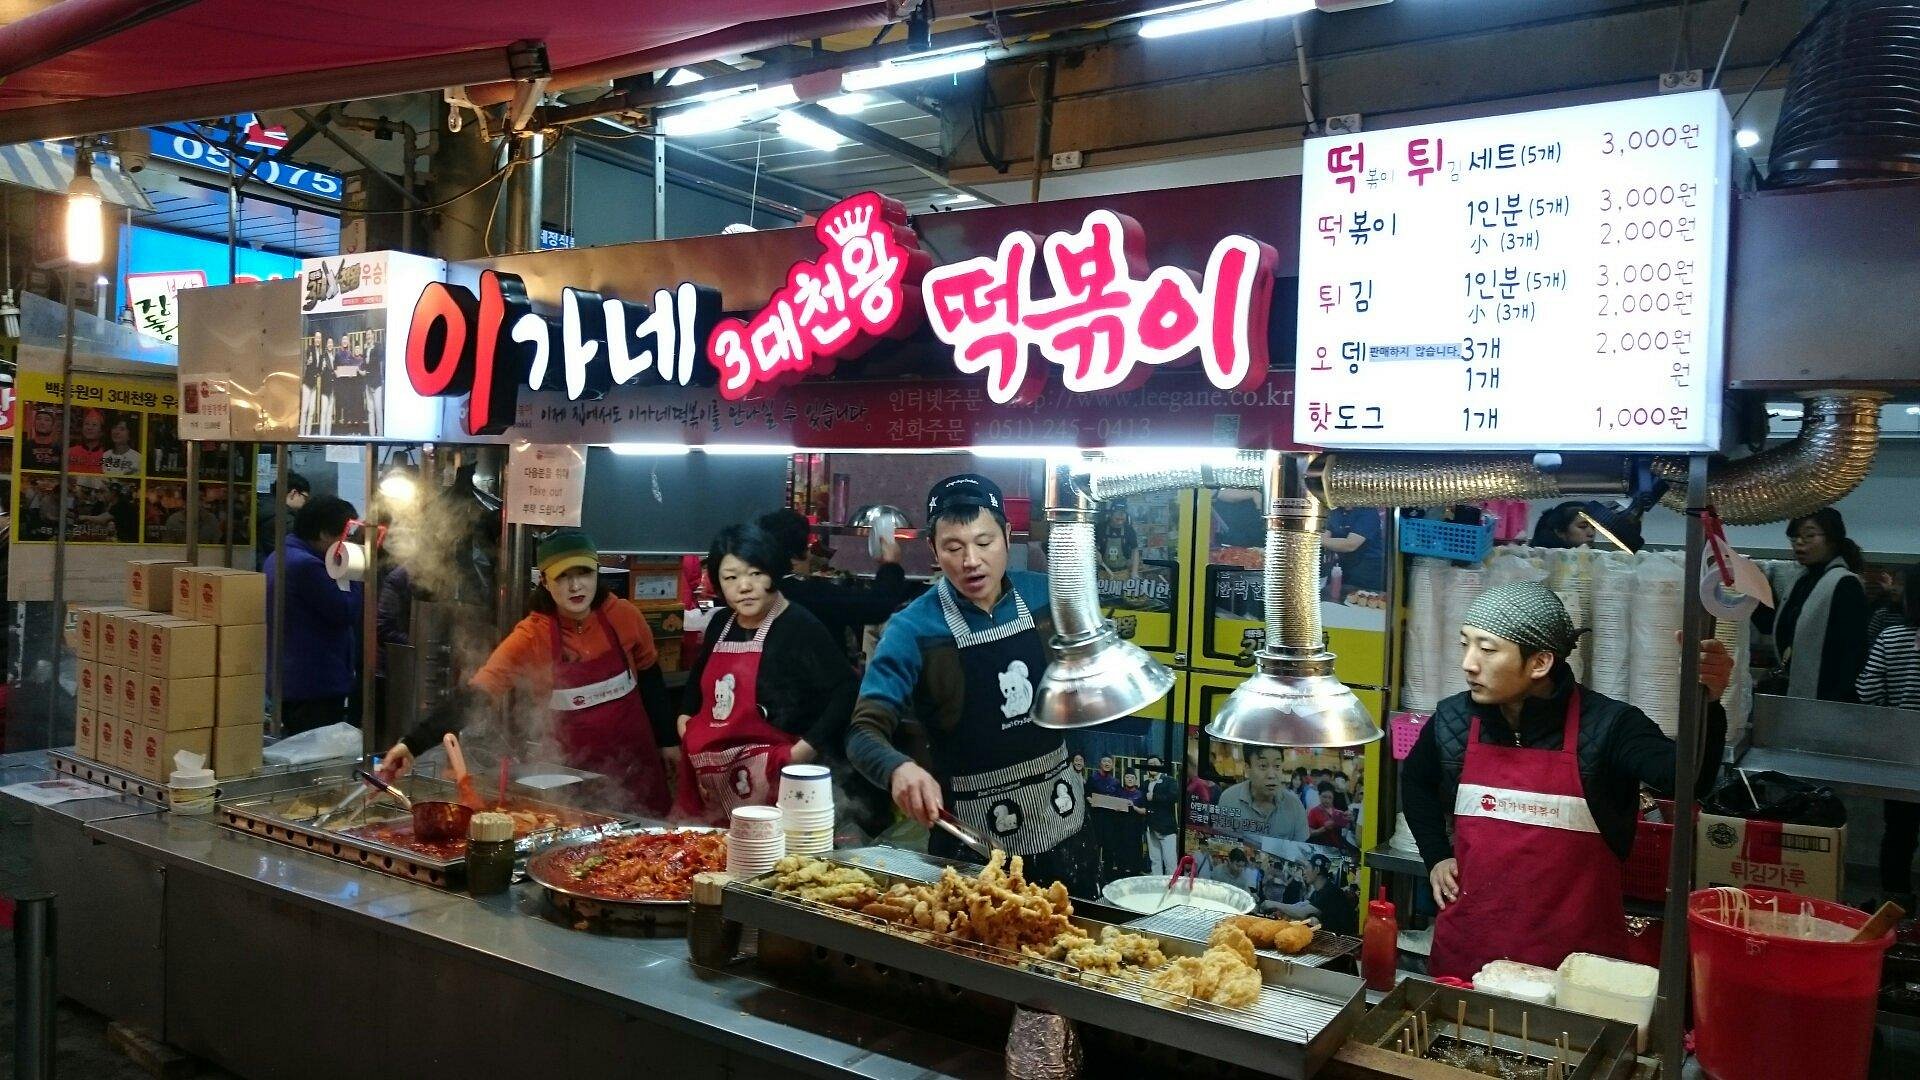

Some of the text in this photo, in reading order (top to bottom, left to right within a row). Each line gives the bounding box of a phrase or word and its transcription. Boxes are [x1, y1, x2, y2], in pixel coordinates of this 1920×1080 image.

[1602, 124, 1699, 155] 3,000원
[1318, 210, 1396, 246] 떡볶이
[1467, 193, 1524, 227] 1인분
[1601, 182, 1697, 212] 3,000원
[1500, 229, 1540, 251] (3개)
[1600, 217, 1696, 245] 2,000원
[1319, 279, 1373, 314] 튀김
[1464, 266, 1521, 299] 1인분
[1597, 260, 1694, 287] 3,000원
[1496, 302, 1535, 322] (3개)
[1598, 291, 1692, 316] 2,000원
[405, 211, 1266, 434] 이가네 3대천왕 떡볶이
[1369, 346, 1409, 358] 판매하지
[1461, 337, 1501, 362] 3개
[1597, 329, 1691, 355] 2,000원
[1465, 362, 1690, 392] 1개 원
[107, 389, 158, 408] 3대천왕
[160, 394, 178, 409] 우
[888, 388, 984, 412] 인터넷주문
[541, 402, 567, 424] 이제
[572, 402, 623, 427] 집에서도
[728, 402, 779, 430] 만나실
[783, 402, 798, 423] 수
[887, 418, 966, 441] 전화주문
[1042, 417, 1151, 441] 245-0413
[1308, 402, 1688, 432] 핫도그 1개 1,000원
[528, 485, 563, 497] Take out
[1729, 861, 1808, 888] 튀김가루
